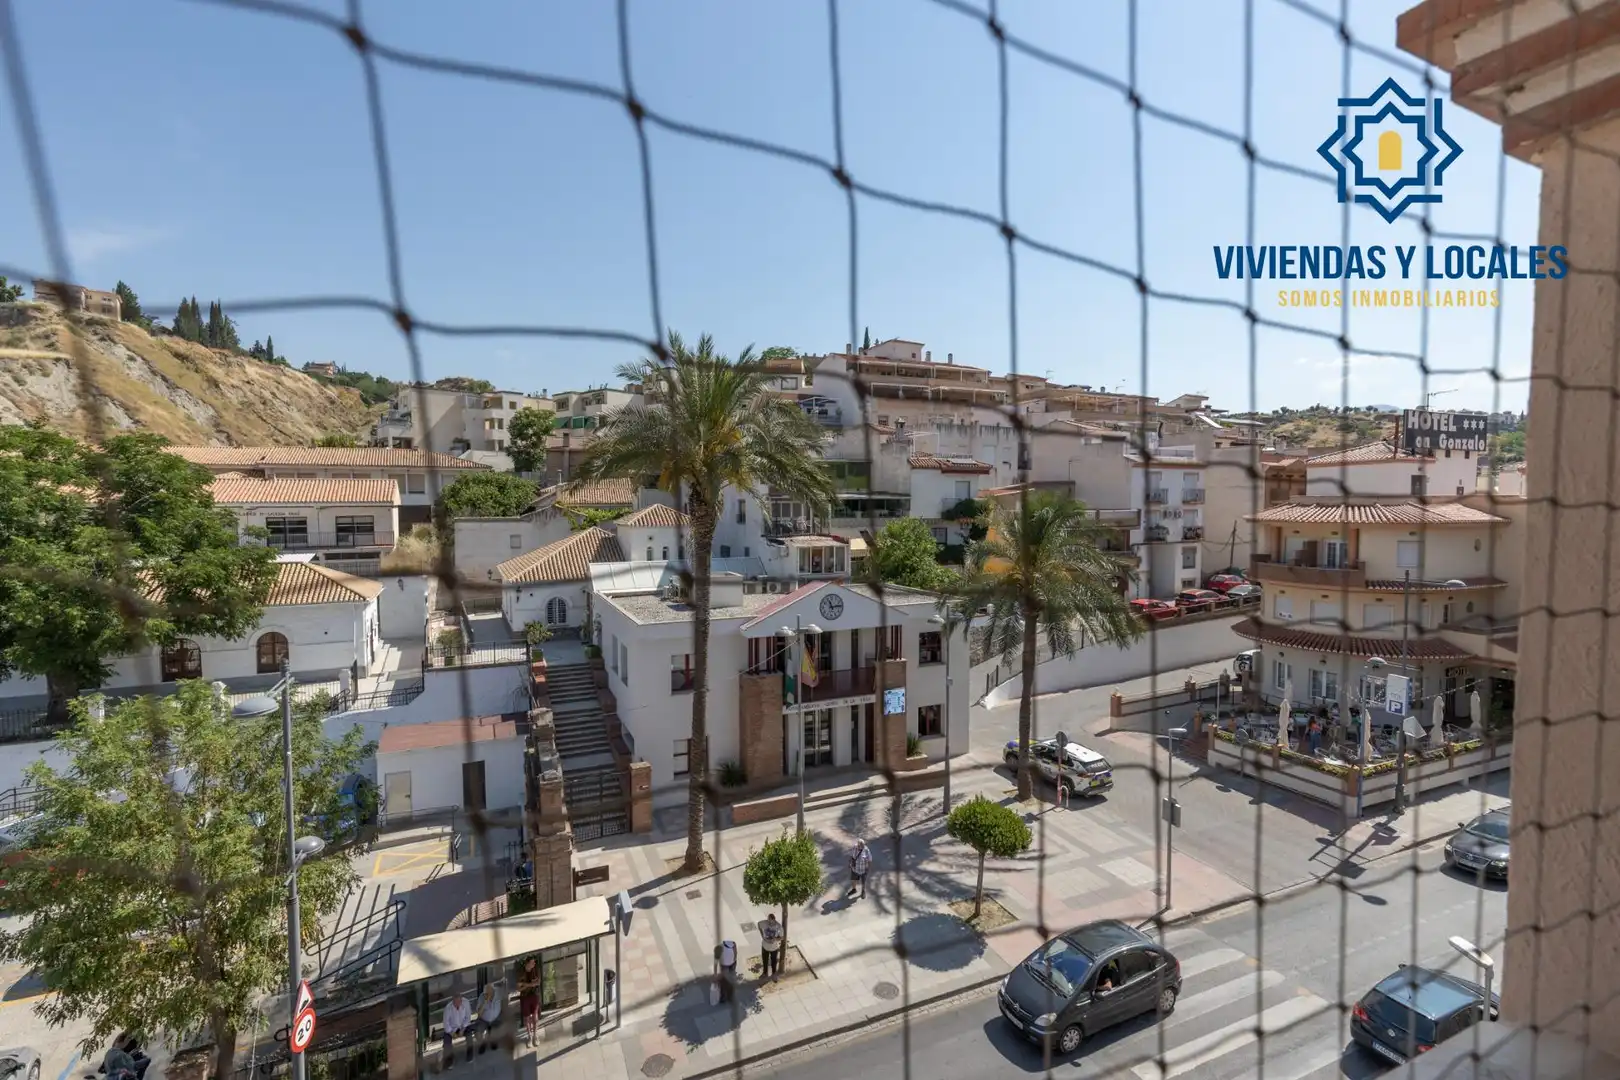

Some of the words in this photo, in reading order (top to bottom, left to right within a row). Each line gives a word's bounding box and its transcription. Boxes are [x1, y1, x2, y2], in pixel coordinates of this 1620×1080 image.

[1407, 410, 1456, 431] HOTEL
[1439, 433, 1485, 450] Gonzalo
[298, 1019, 311, 1042] 20
